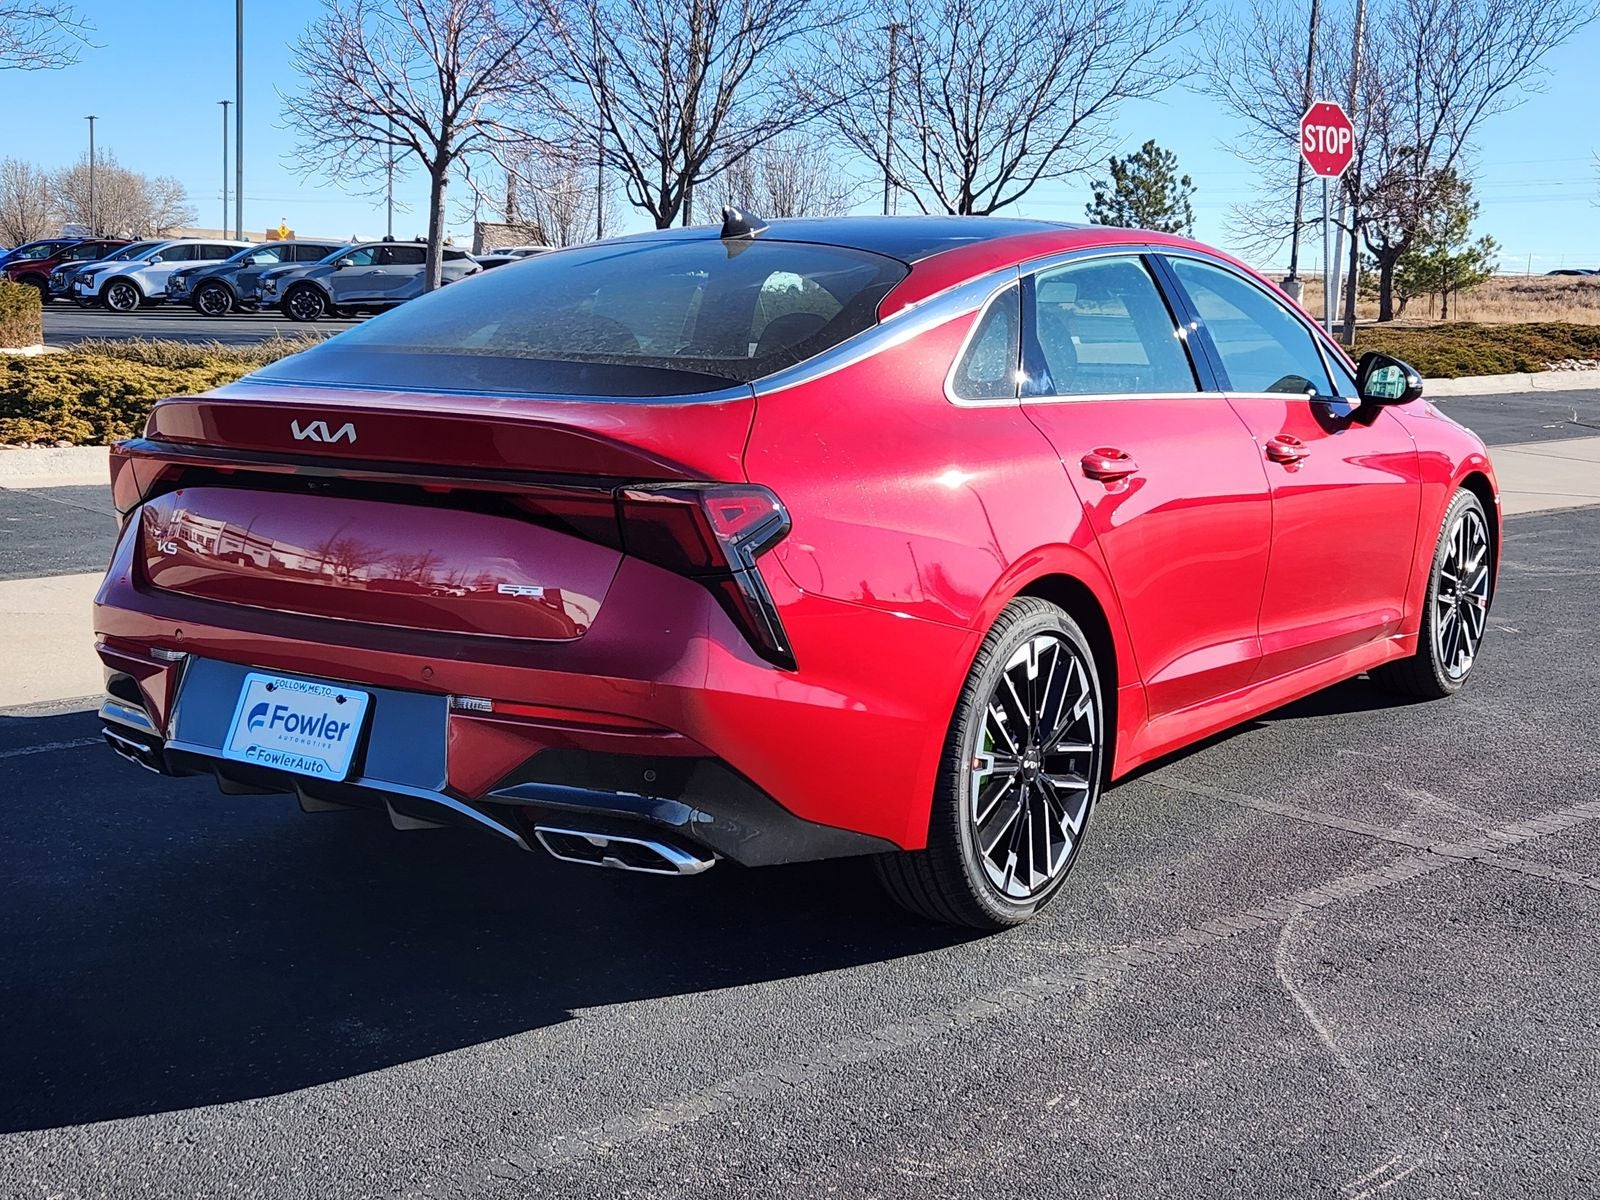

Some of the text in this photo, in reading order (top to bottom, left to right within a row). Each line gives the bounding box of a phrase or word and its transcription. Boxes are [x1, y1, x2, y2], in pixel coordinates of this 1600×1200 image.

[1304, 124, 1350, 154] STOP
[291, 419, 357, 444] KIA
[157, 540, 178, 555] K5
[269, 704, 350, 742] Fowler
[278, 735, 332, 749] AUTOMOTIVE
[257, 749, 323, 773] FowlerAuto
